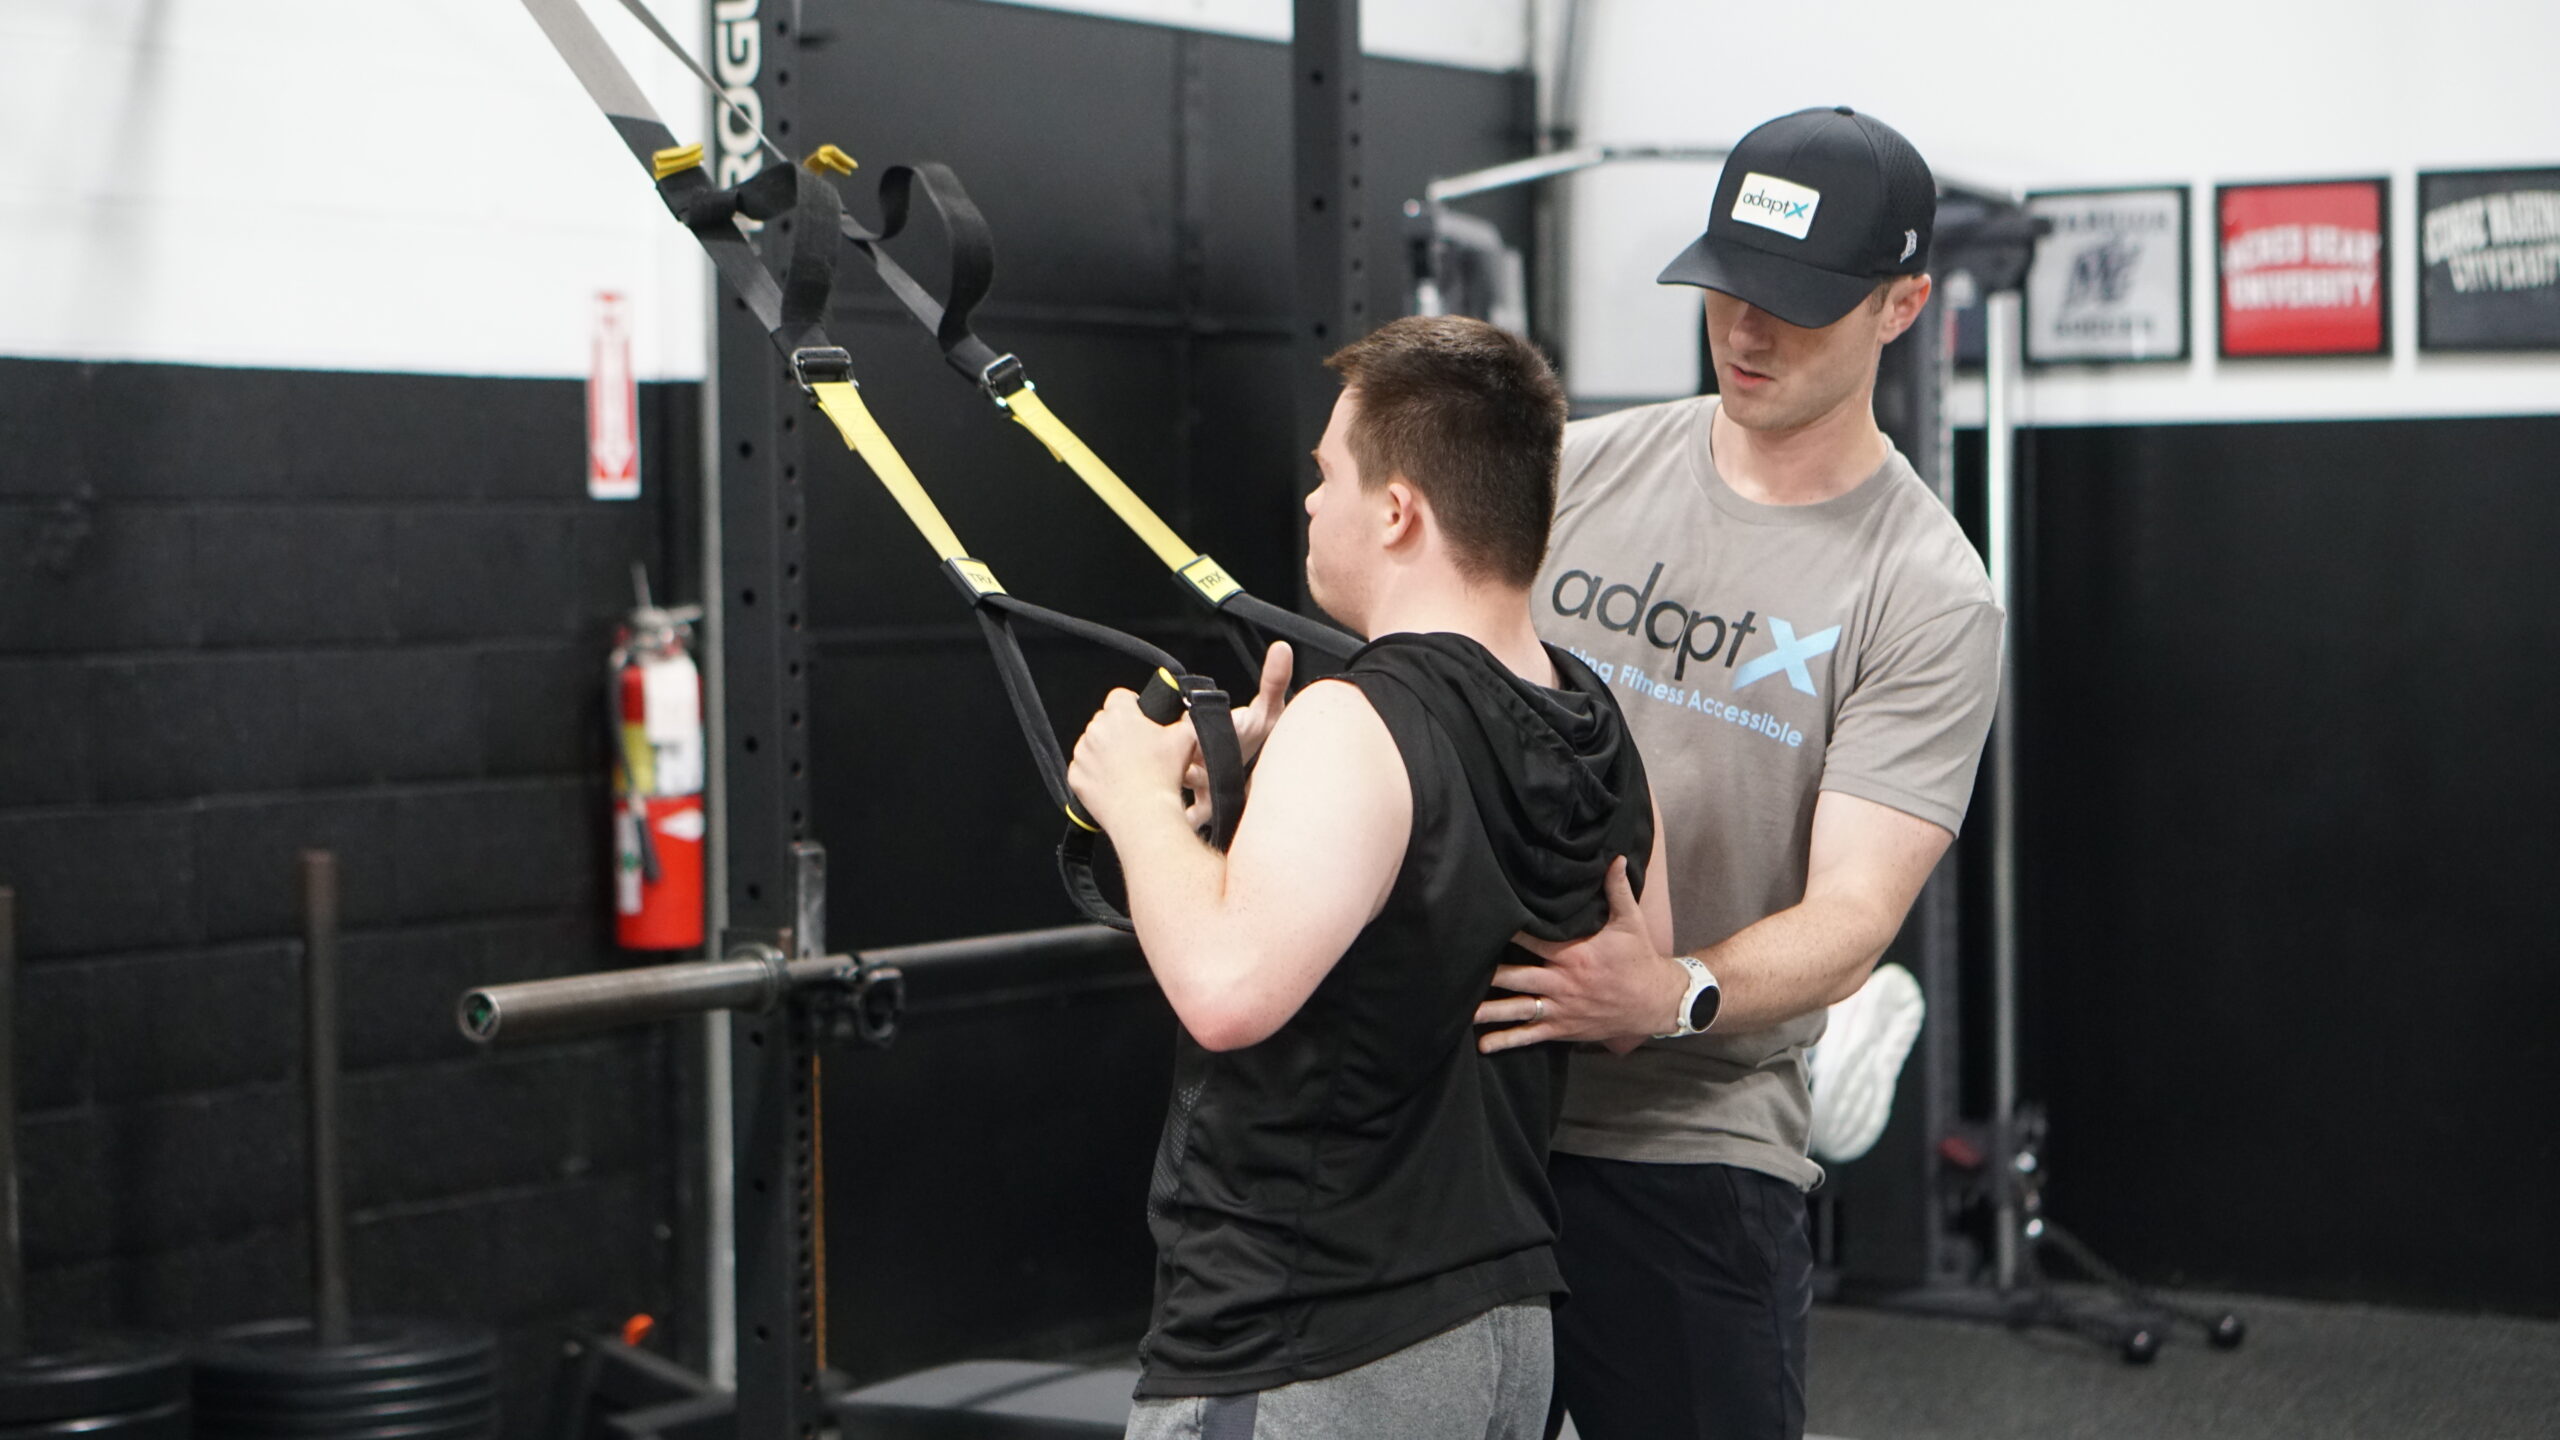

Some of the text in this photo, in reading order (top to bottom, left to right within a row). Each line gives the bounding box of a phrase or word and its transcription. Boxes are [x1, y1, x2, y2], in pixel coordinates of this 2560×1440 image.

[1198, 570, 1225, 589] TRX
[1619, 664, 1685, 705] Fitness
[1687, 689, 1804, 748] Accessible
